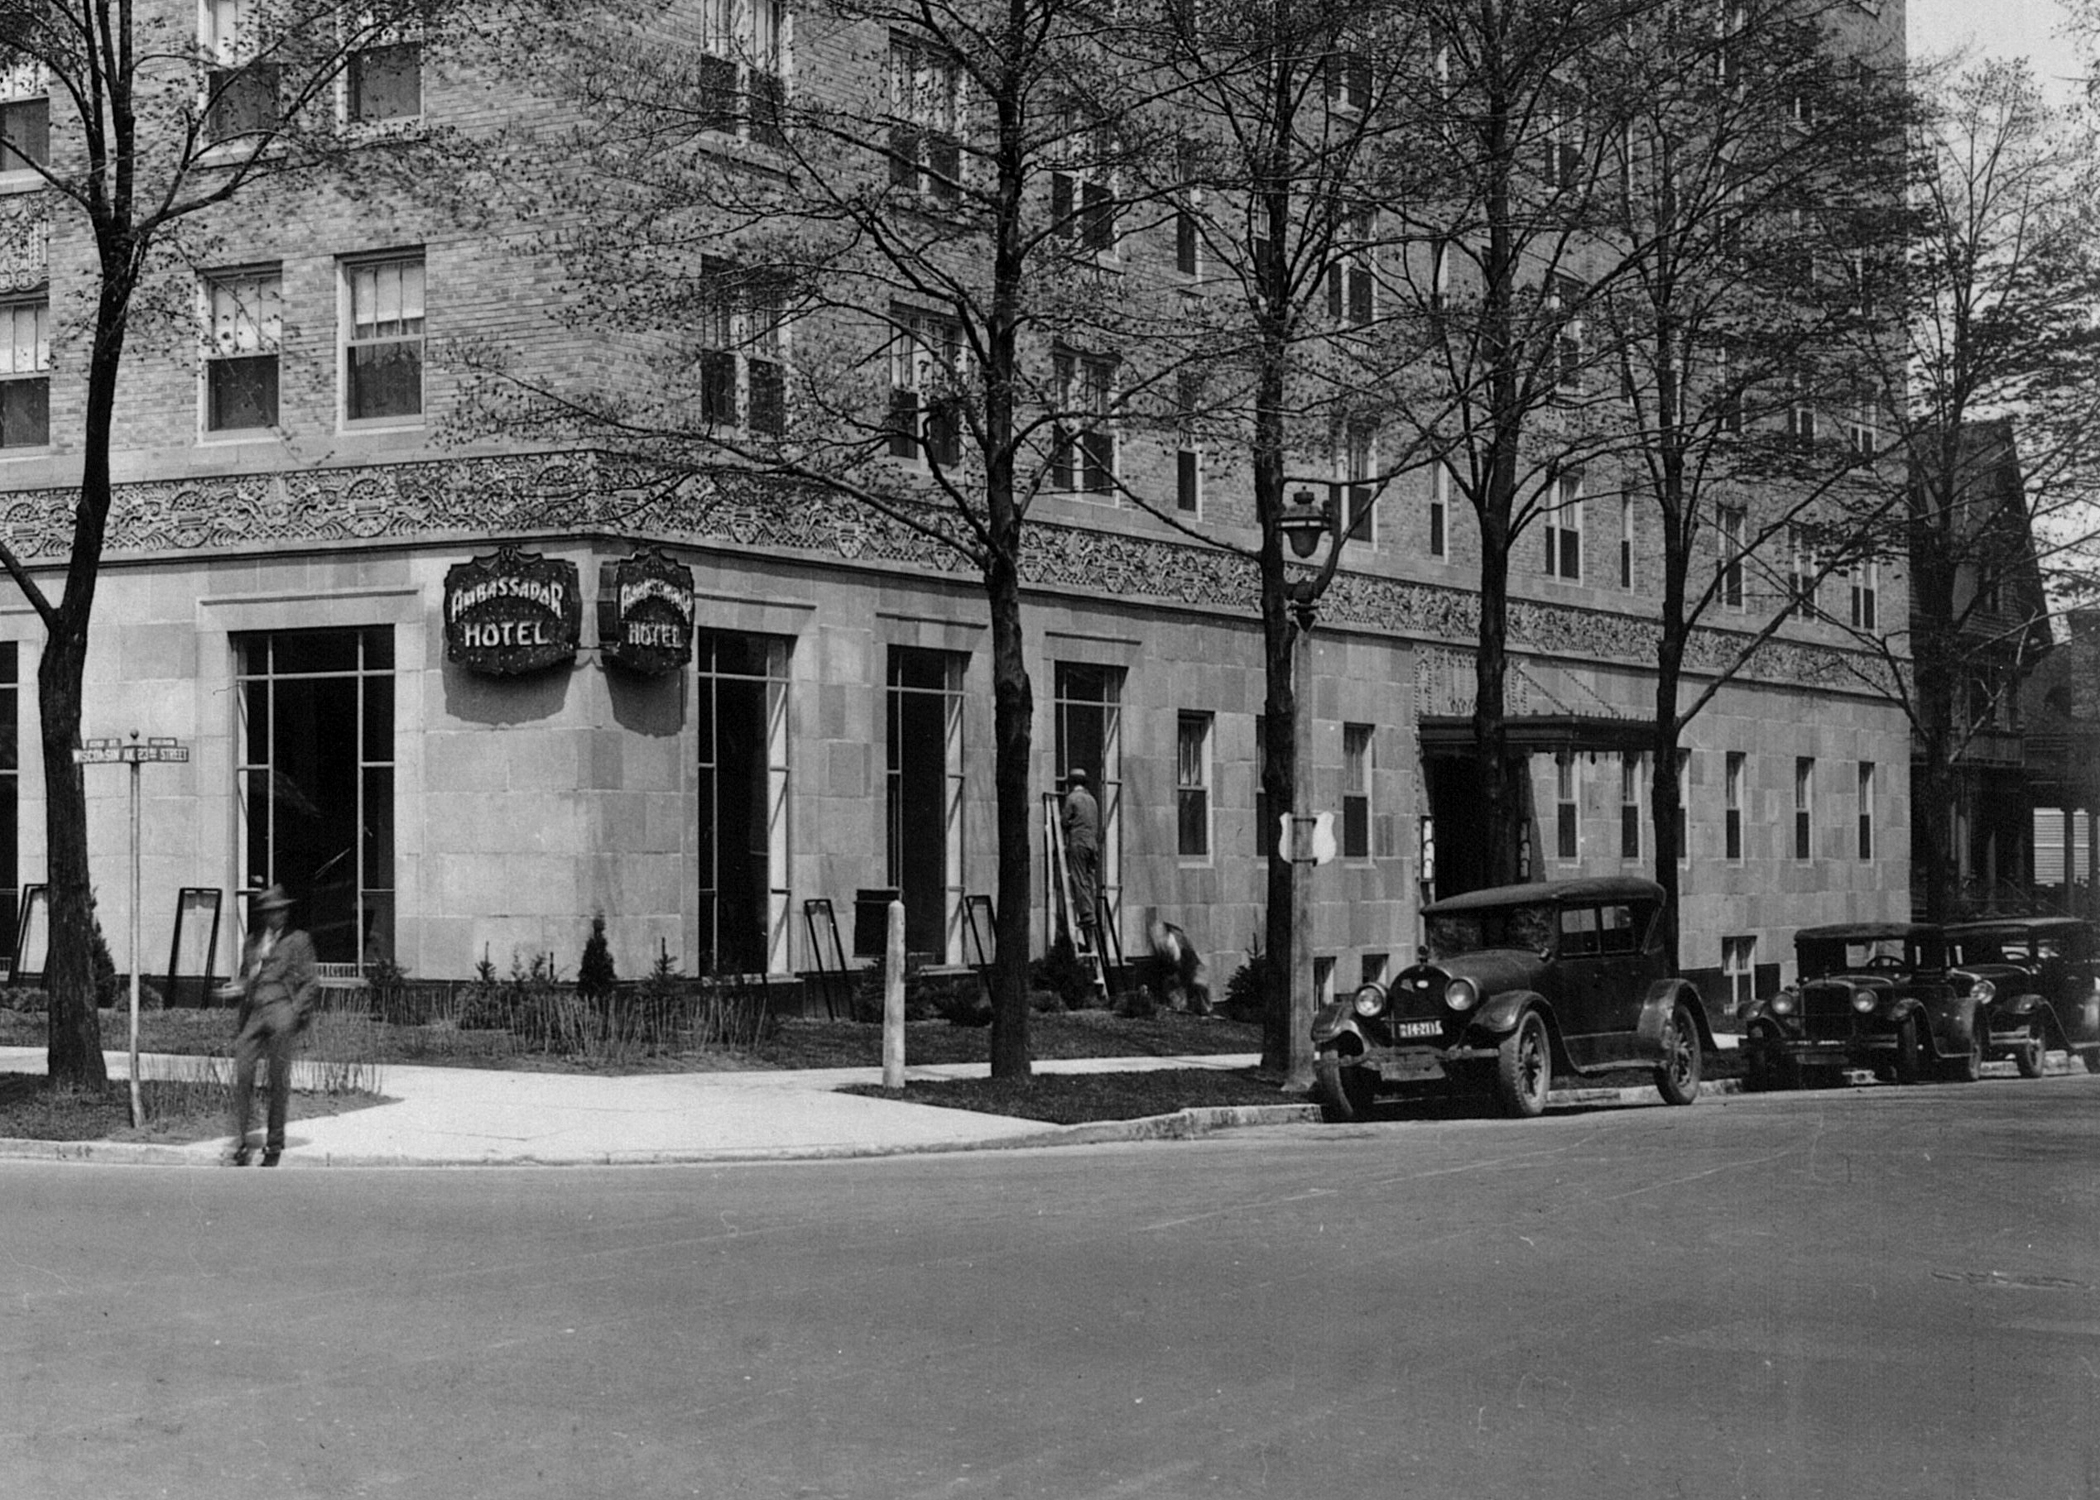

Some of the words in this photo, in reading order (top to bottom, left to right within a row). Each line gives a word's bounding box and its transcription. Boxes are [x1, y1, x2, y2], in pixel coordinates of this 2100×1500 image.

[451, 577, 563, 623] AMBASSADOR
[464, 621, 549, 647] HOTEL
[628, 622, 684, 649] HOTEL
[159, 748, 188, 761] STREET
